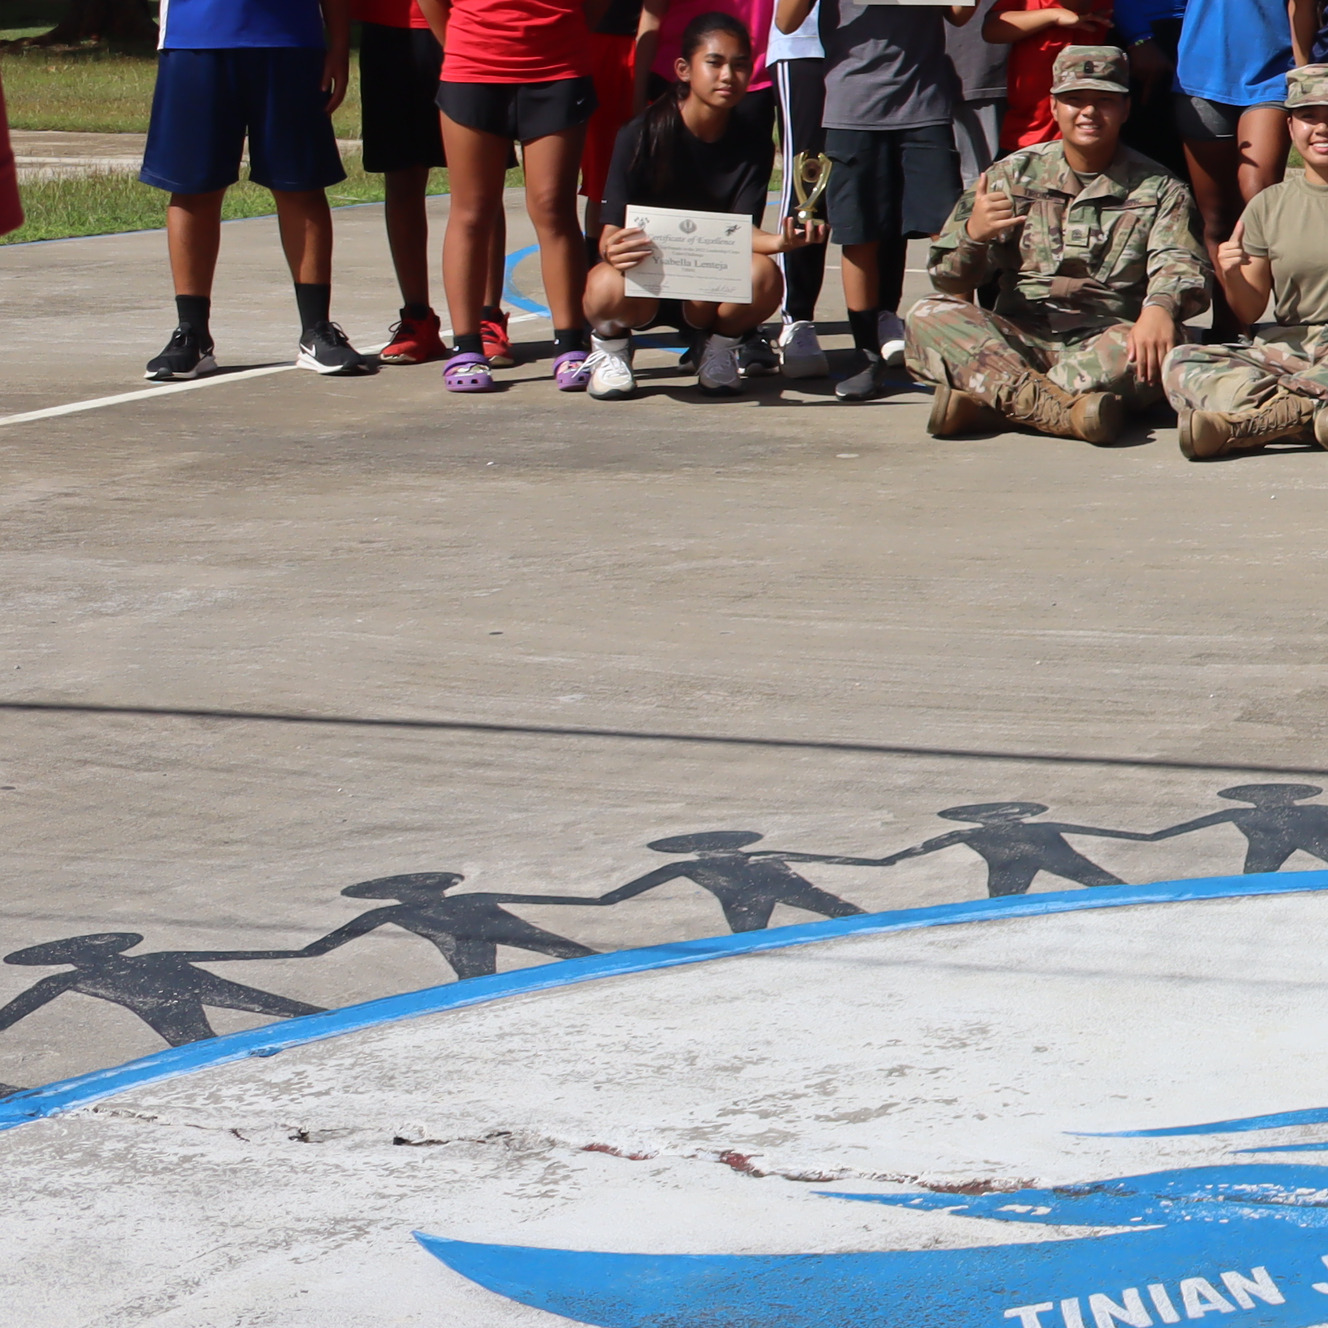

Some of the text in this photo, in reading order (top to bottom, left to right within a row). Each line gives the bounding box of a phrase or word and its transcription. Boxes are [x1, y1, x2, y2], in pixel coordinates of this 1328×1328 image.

[686, 235, 696, 245] of
[697, 235, 736, 246] Excellence
[652, 256, 692, 267] Ysabella
[694, 258, 728, 271] Lenteja
[1003, 1266, 1286, 1328] TINIAN
